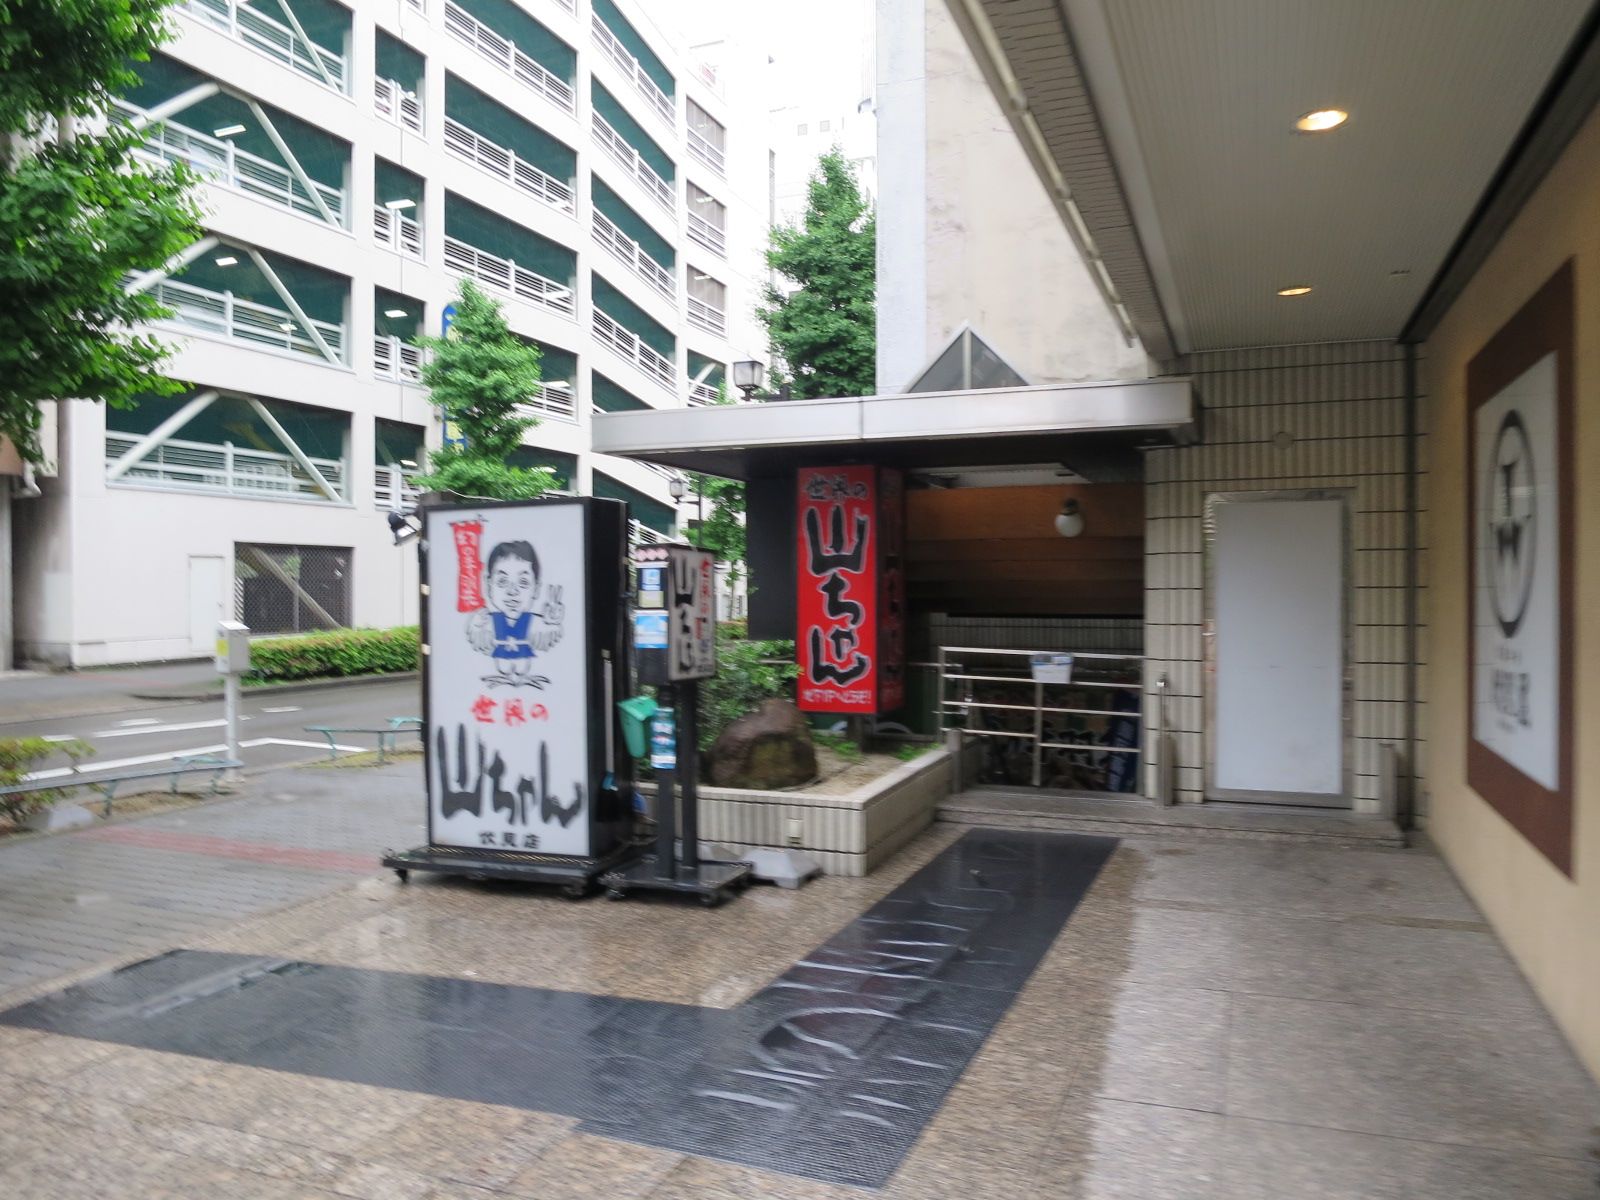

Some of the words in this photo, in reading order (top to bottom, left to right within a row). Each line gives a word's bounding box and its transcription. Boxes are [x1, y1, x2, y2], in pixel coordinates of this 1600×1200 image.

[806, 474, 868, 501] 世界の
[806, 504, 872, 687] 山ちゃん
[436, 723, 583, 828] 山ちゃん
